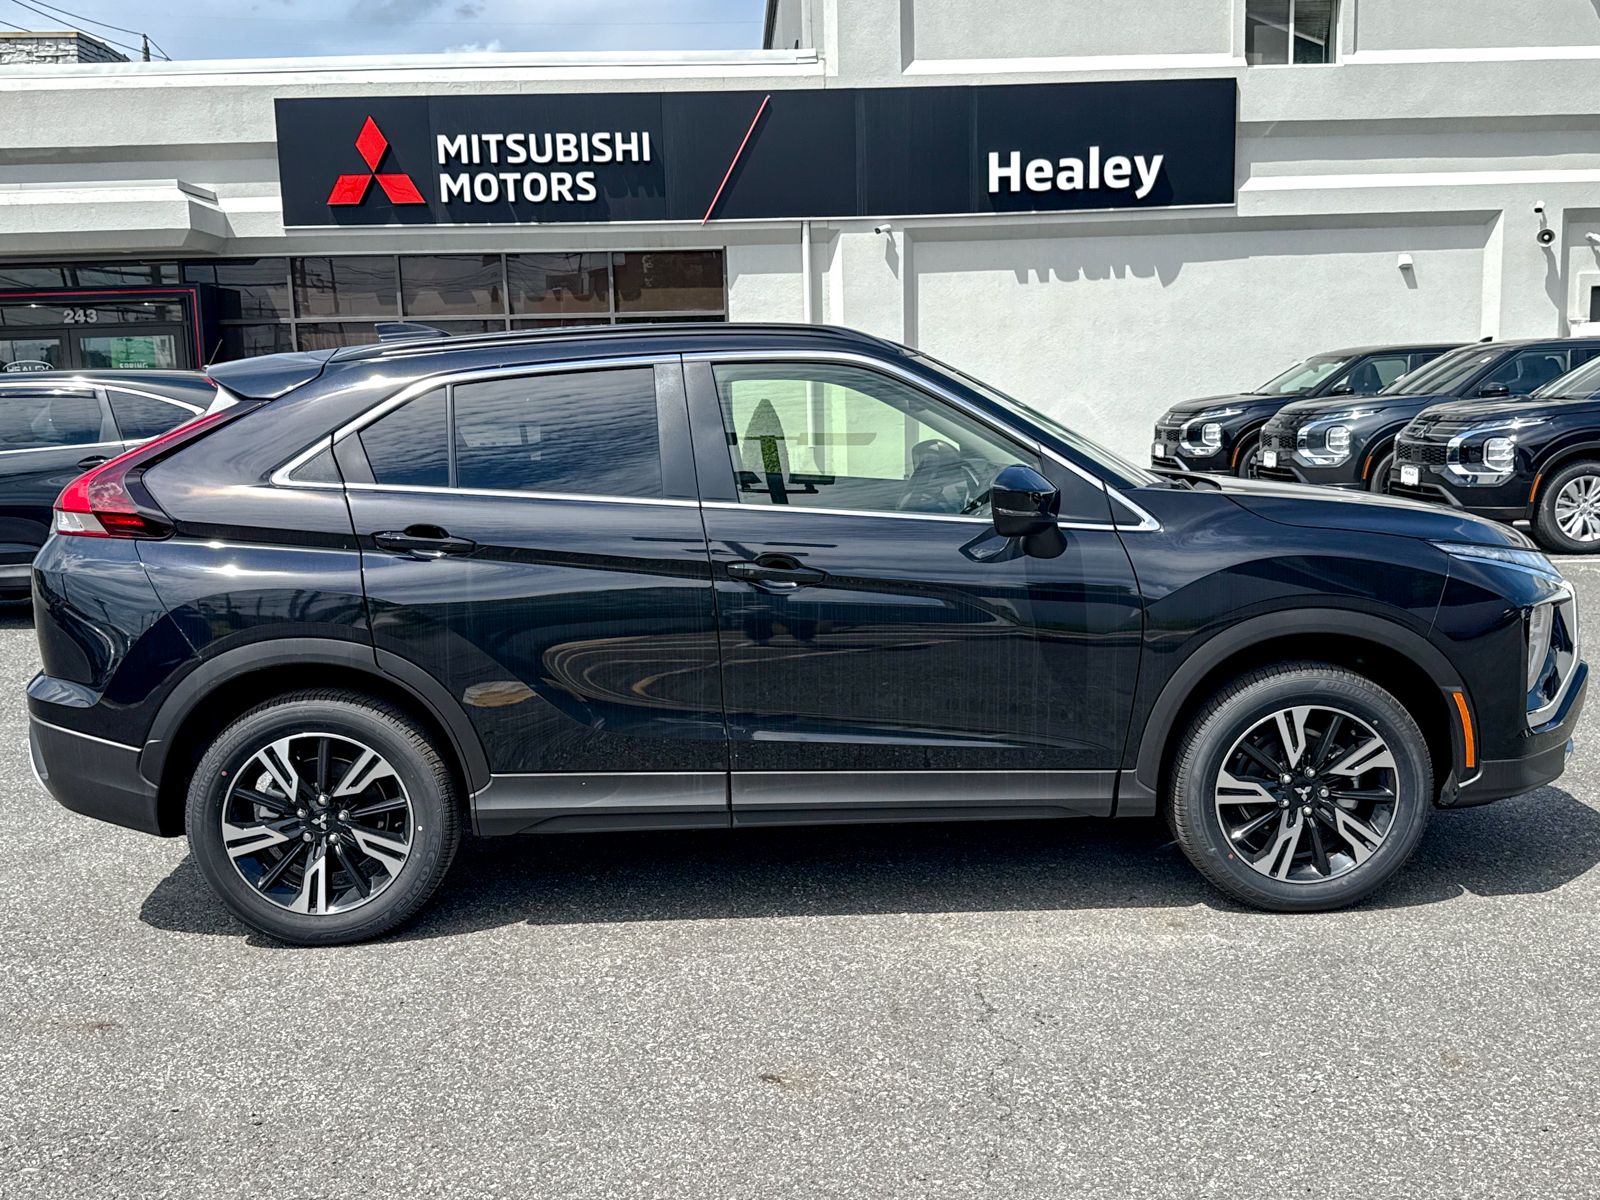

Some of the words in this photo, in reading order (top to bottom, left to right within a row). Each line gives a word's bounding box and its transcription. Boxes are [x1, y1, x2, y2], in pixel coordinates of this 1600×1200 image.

[437, 132, 650, 164] MITSUBISHI
[440, 171, 597, 202] MOTORS
[988, 146, 1164, 199] Healey
[63, 309, 98, 324] 243
